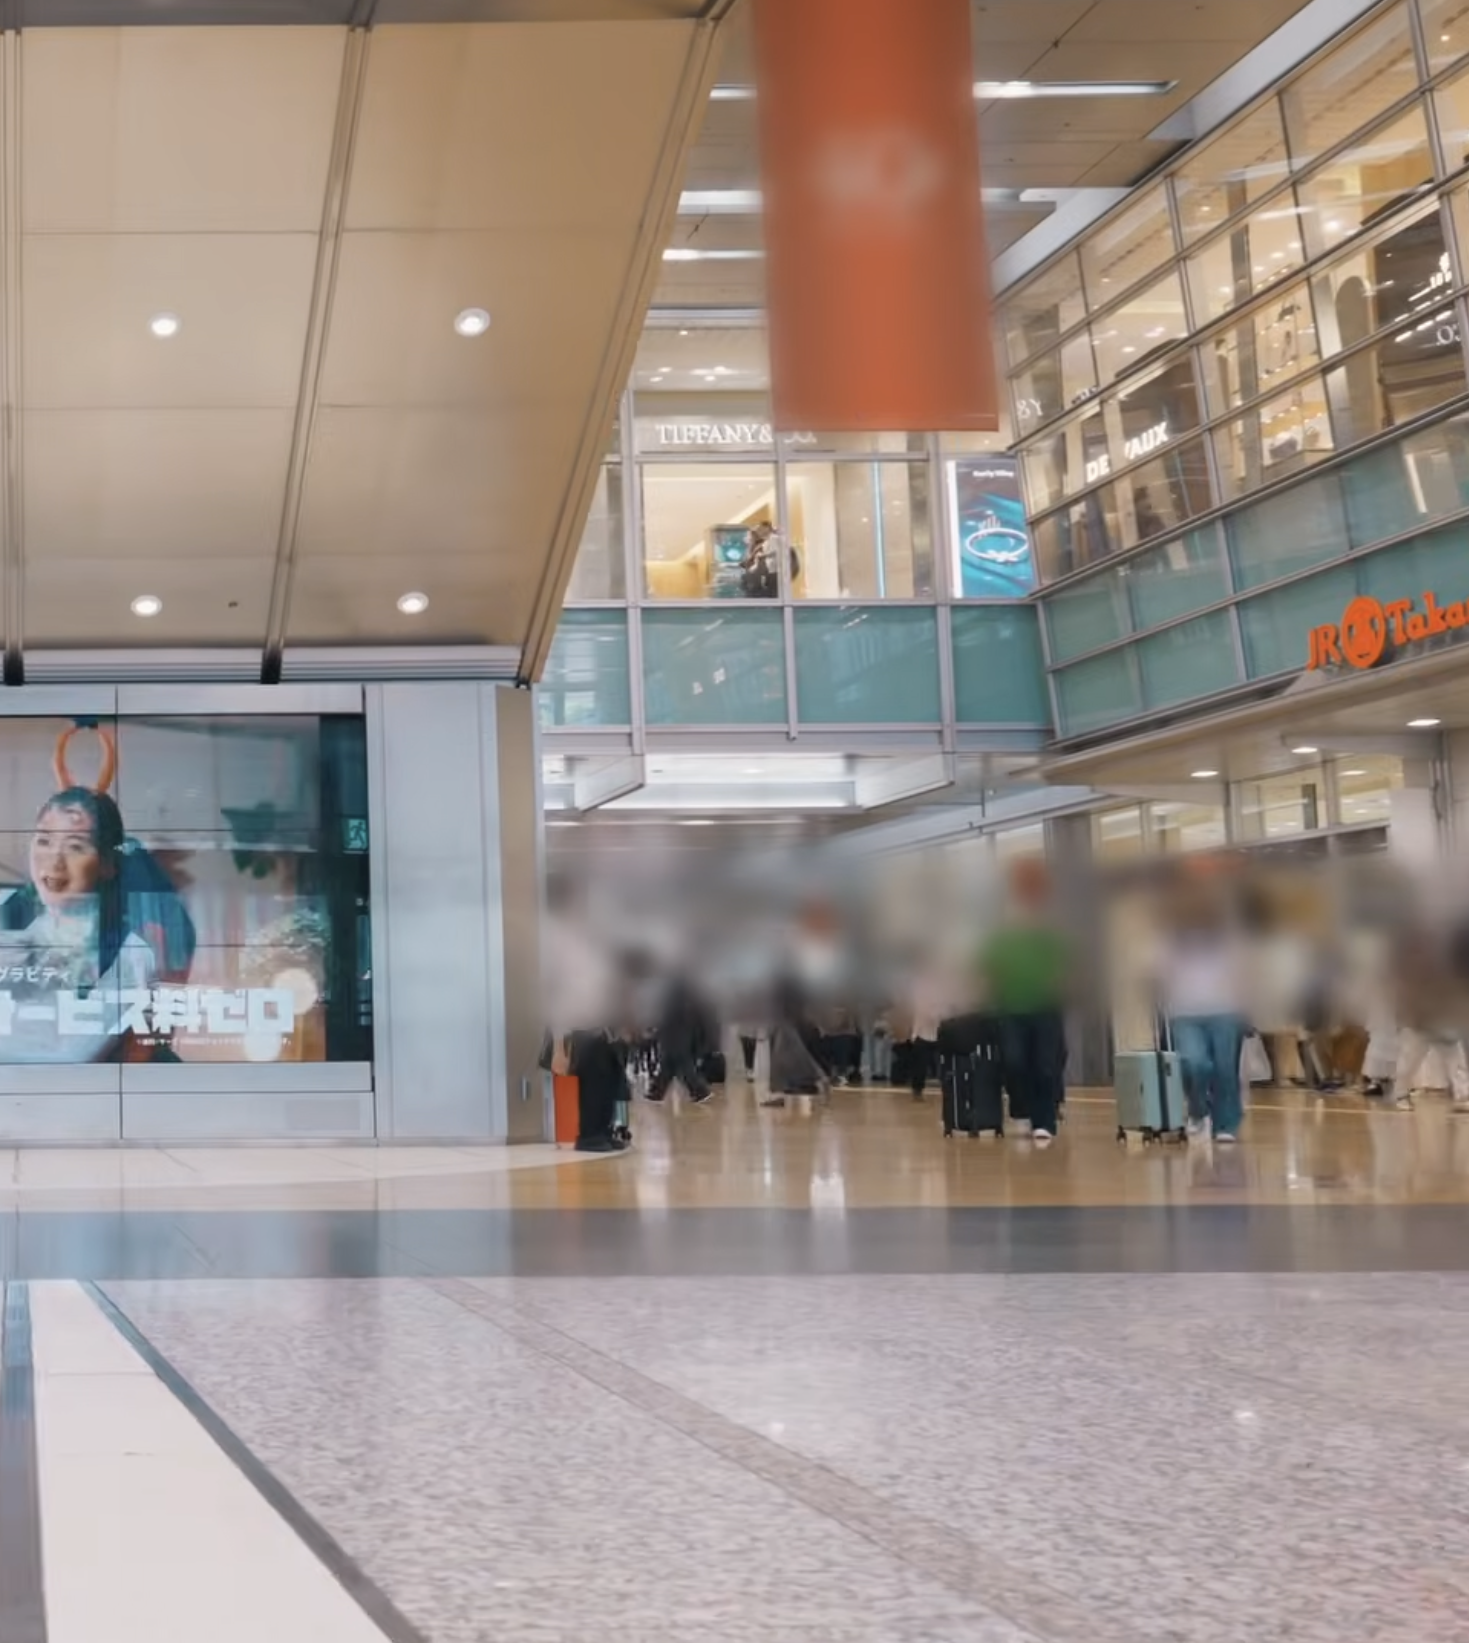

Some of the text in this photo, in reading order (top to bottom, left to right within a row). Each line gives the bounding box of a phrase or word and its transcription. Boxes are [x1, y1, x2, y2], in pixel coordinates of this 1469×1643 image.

[1085, 421, 1170, 484] DEAUX
[1306, 590, 1469, 672] JR Taka
